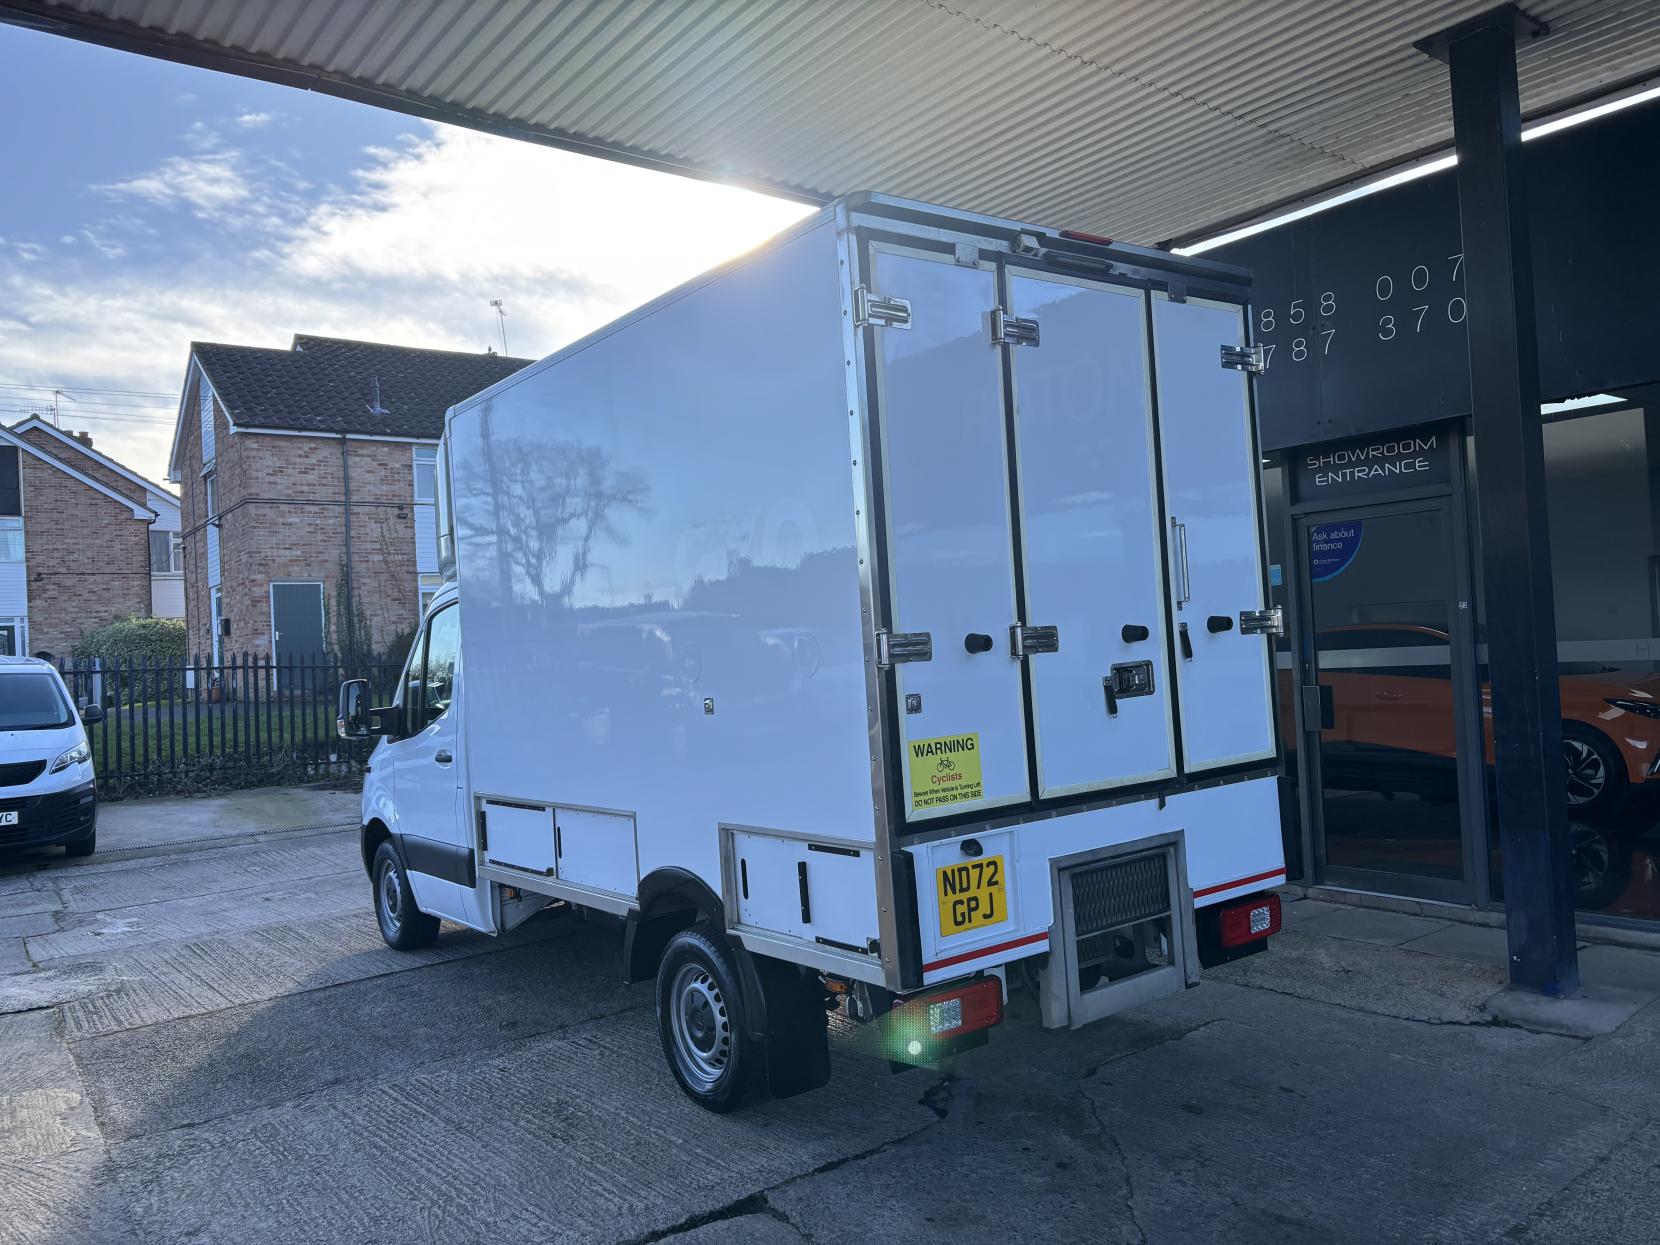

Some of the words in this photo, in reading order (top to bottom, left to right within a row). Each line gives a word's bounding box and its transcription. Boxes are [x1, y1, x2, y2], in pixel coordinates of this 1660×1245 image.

[1260, 291, 1336, 332] 858
[1376, 253, 1464, 301] 007
[1263, 329, 1336, 368] 787
[1378, 297, 1467, 340] 370
[1307, 436, 1437, 469] SHOWROOM
[1315, 457, 1430, 486] ENTRANCE
[1312, 531, 1328, 541] Ask
[1330, 529, 1355, 539] about
[1312, 542, 1343, 552] finance
[913, 737, 975, 758] WARNING
[930, 772, 963, 786] Cyclists
[959, 783, 974, 791] Turning
[914, 799, 923, 808] DO
[923, 797, 935, 806] NOT
[935, 795, 950, 804] PASS
[950, 793, 958, 801] ON
[958, 791, 970, 800] THIS
[970, 789, 983, 798] SIDE
[942, 859, 999, 897] ND72
[952, 892, 995, 927] GPJ
